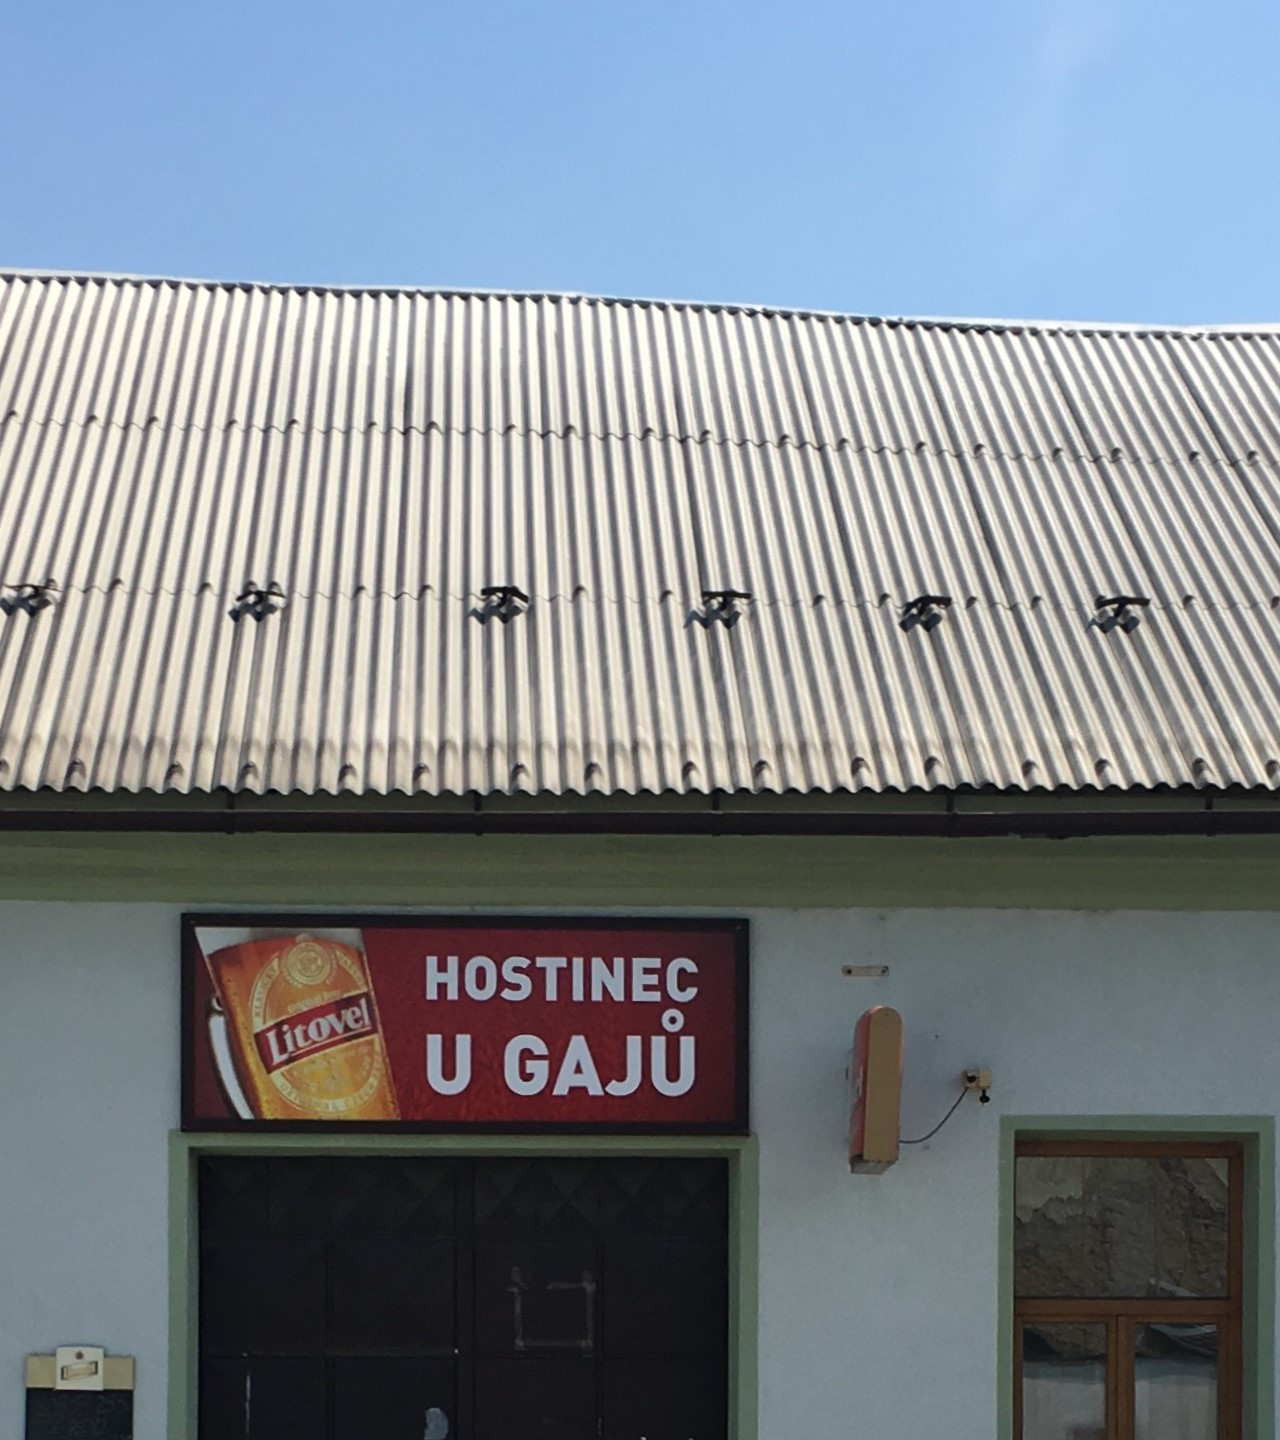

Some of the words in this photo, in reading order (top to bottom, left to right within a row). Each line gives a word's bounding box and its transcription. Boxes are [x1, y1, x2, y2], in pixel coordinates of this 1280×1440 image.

[426, 955, 699, 1003] HOSTINEC
[266, 997, 371, 1066] Litovel
[426, 1034, 472, 1096] U
[504, 1008, 696, 1097] GAJŮ
